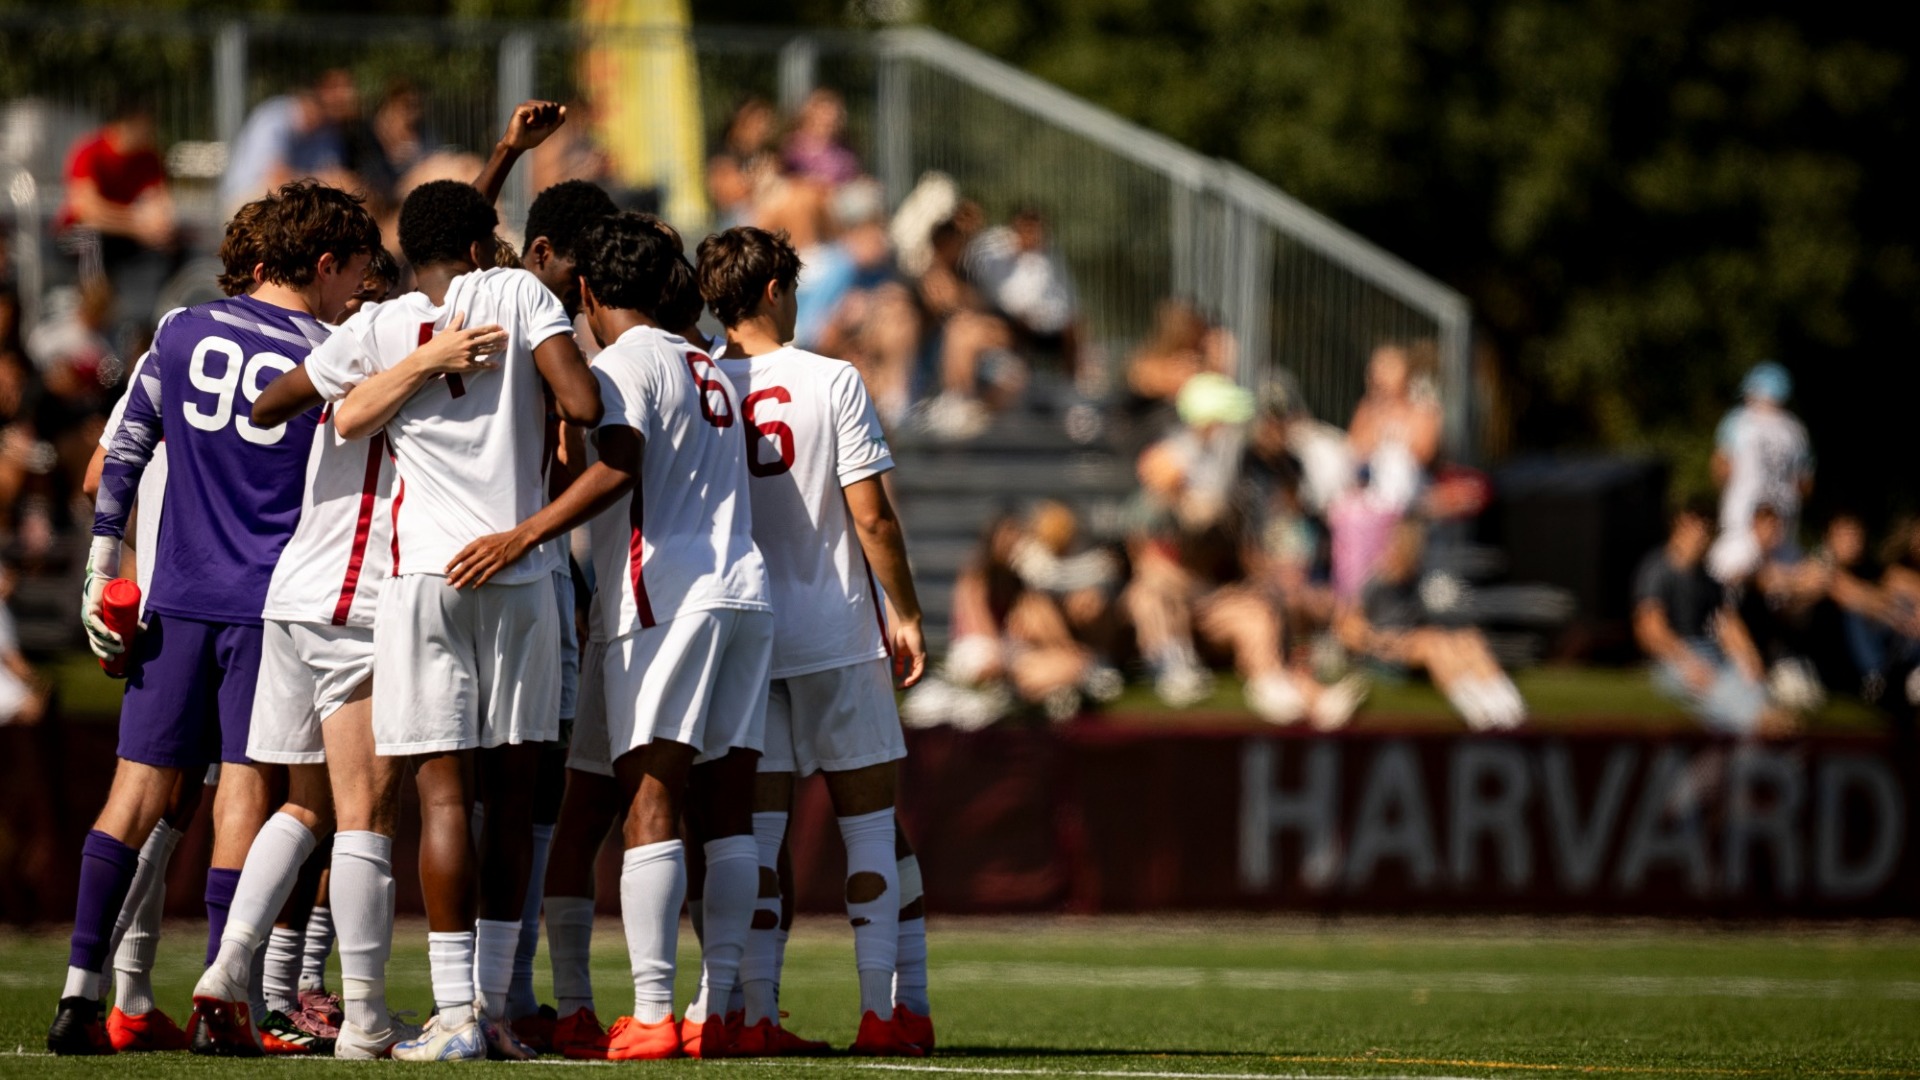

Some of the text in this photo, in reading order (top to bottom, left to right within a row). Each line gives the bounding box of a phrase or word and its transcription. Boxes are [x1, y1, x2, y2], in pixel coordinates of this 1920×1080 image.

[183, 335, 298, 446] 99
[686, 351, 733, 428] 6
[741, 385, 795, 478] 6
[1239, 741, 1903, 896] HARVARD
